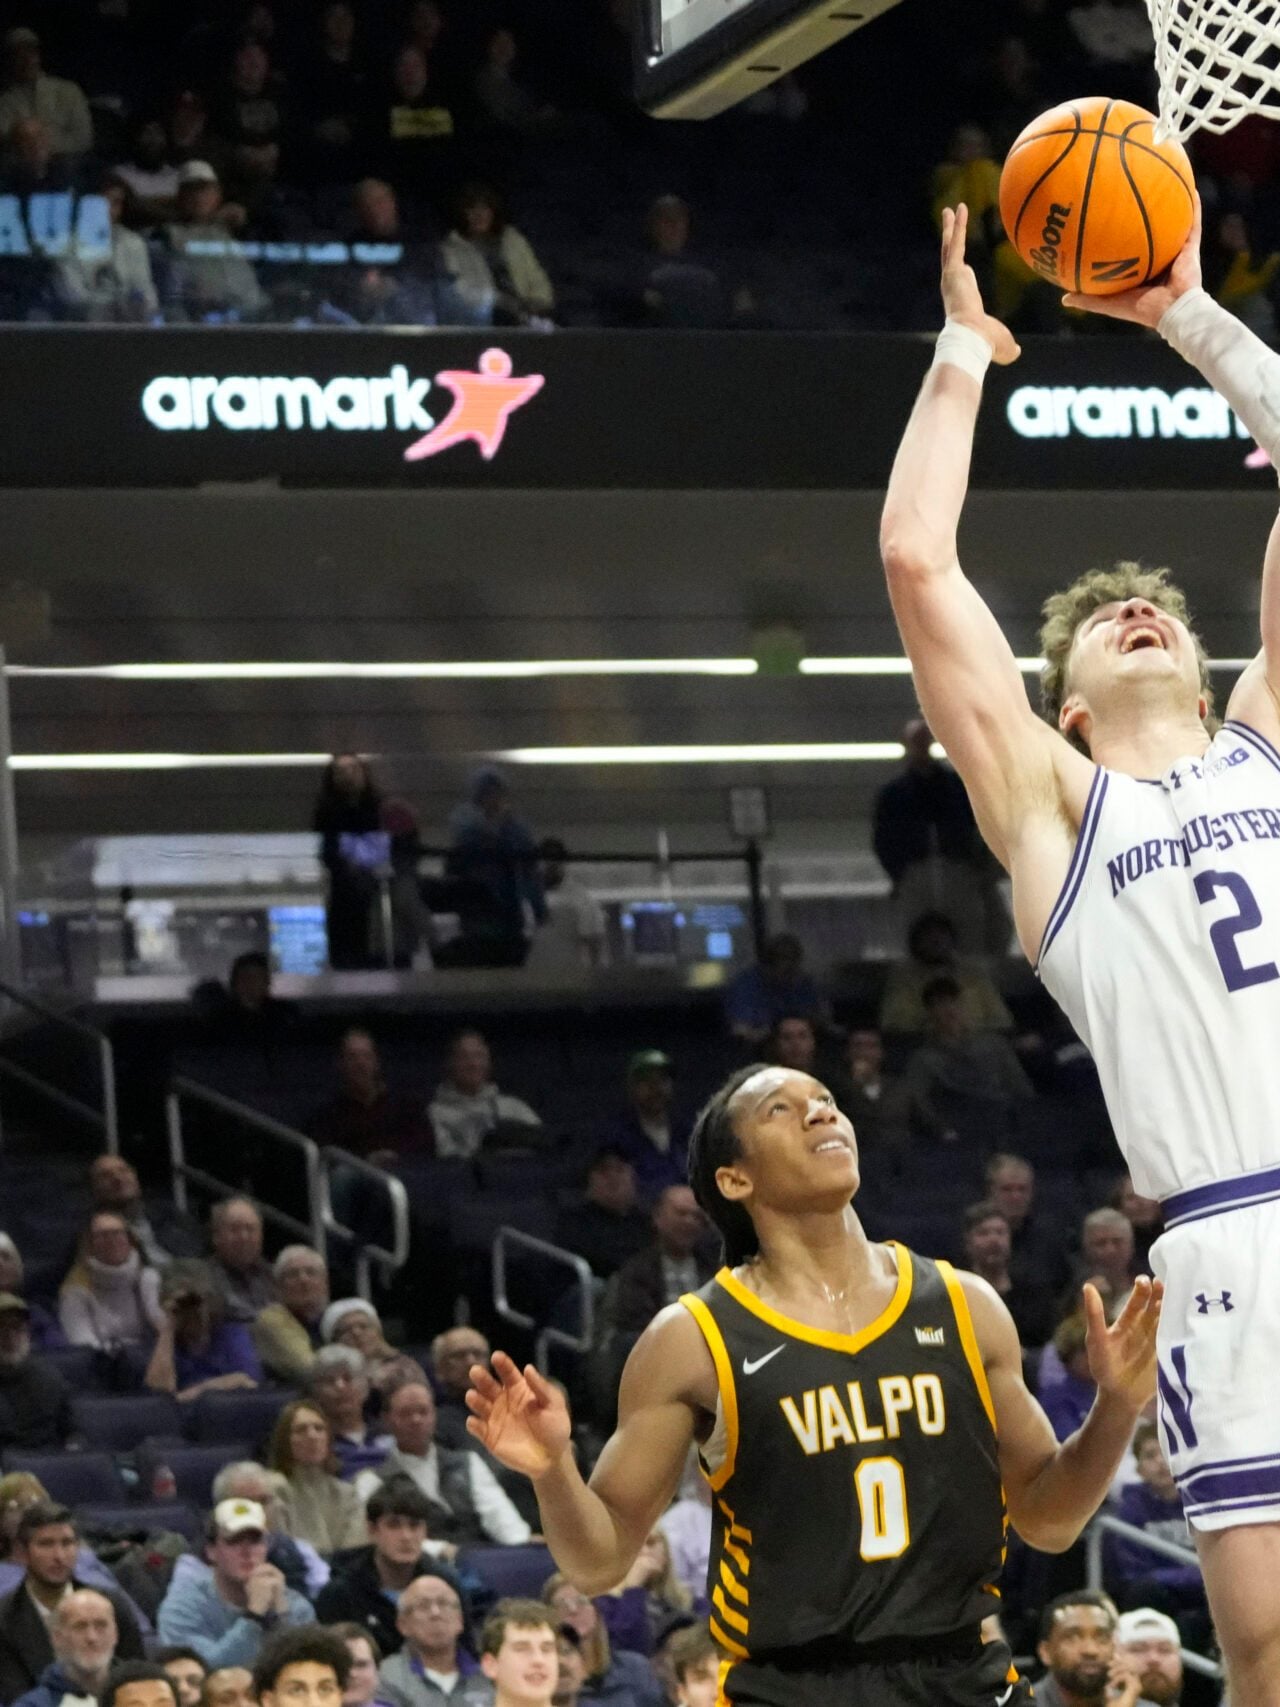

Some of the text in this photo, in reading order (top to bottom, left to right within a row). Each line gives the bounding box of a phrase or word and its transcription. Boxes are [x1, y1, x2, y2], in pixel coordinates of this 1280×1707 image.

[1029, 202, 1071, 285] ilson
[142, 364, 435, 430] aramark
[1007, 385, 1251, 438] aramar
[1193, 869, 1280, 993] 2
[779, 1373, 946, 1457] VALPO
[853, 1455, 911, 1563] 0
